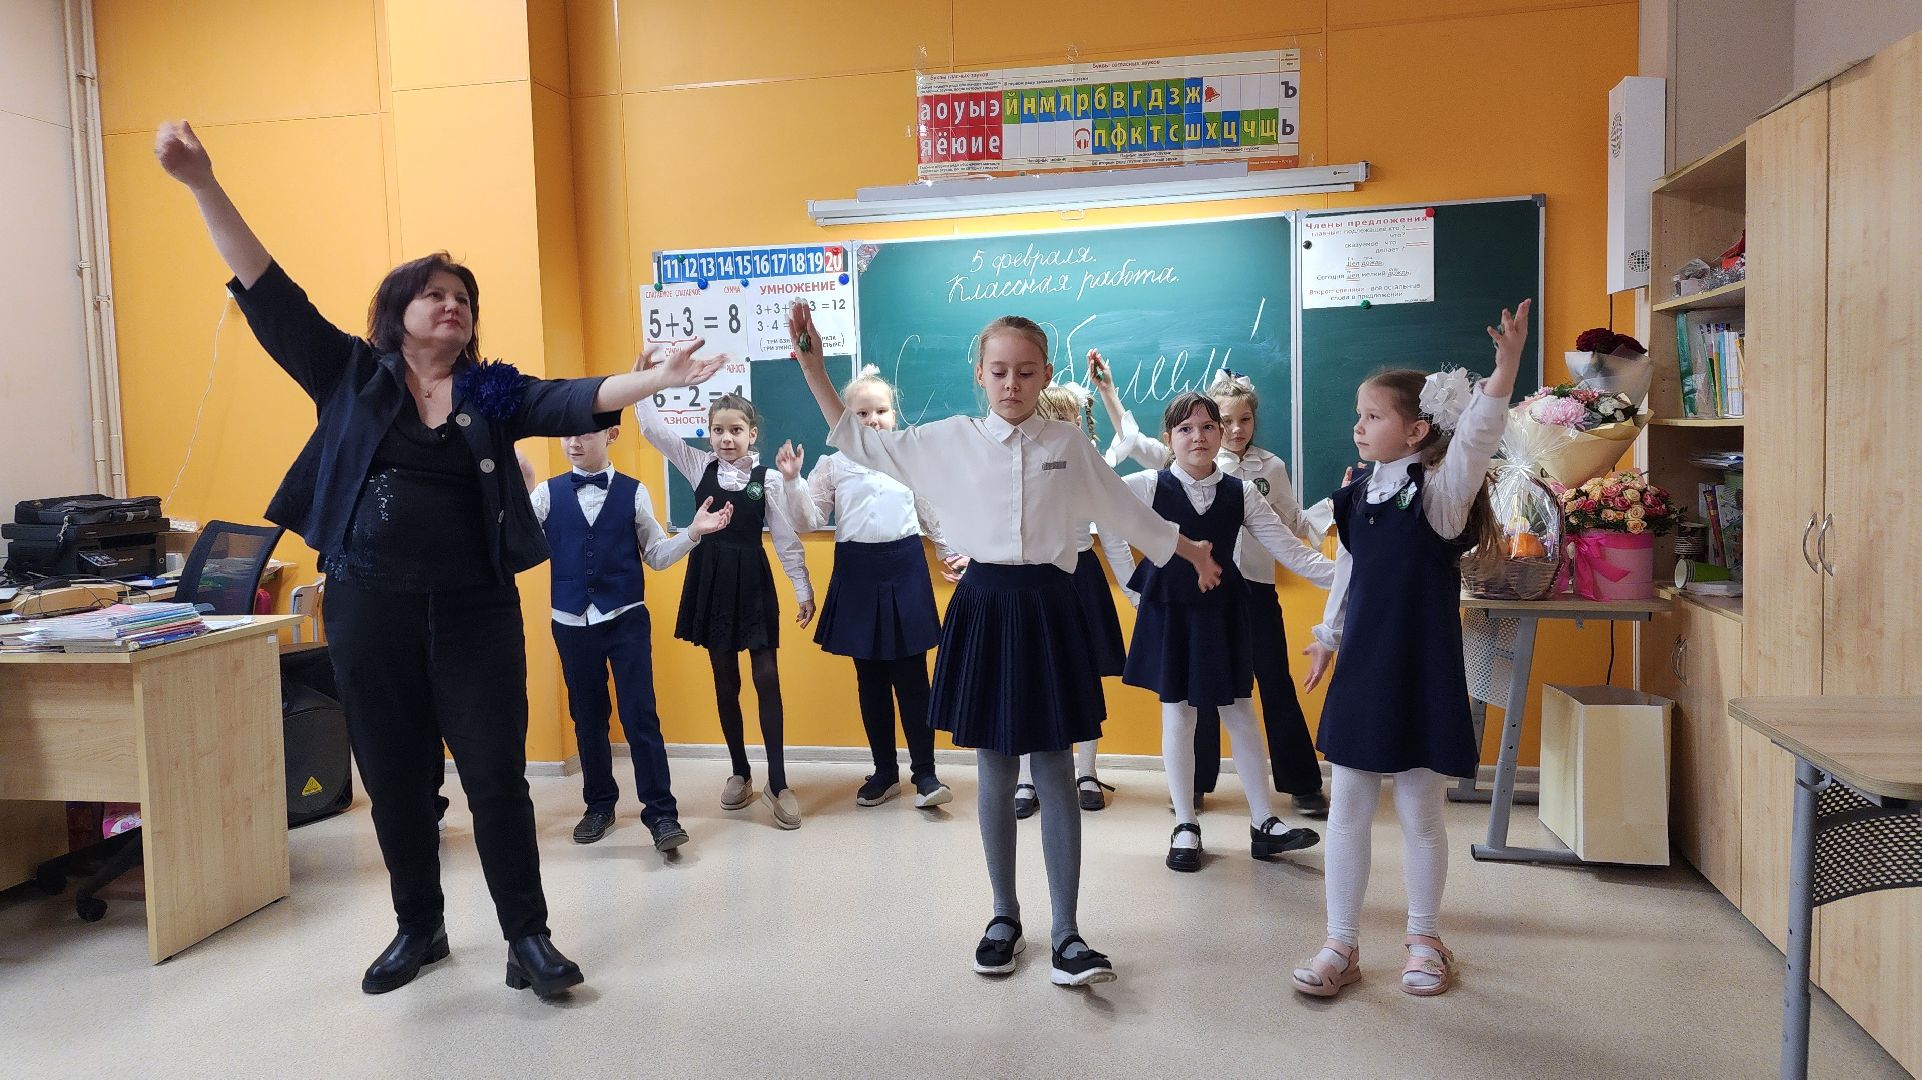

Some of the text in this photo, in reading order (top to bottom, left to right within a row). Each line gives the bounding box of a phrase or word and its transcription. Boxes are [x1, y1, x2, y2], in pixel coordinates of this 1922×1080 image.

[920, 80, 1298, 124] а о у ы э й н м л р б в г д з ж ъ
[920, 119, 1294, 156] я ё ю и е п ф к т с ш х ц ч щ ь
[1305, 216, 1428, 230] Члены предложения
[664, 252, 842, 278] 11 12 13 14 15 16 17 18 19 20
[970, 243, 1097, 276] 5 февраля.
[760, 280, 836, 296] УМНОЖЕНИЕ
[946, 258, 1180, 304] Классная работа.
[653, 392, 666, 408] 6
[689, 386, 700, 407] 2
[664, 416, 707, 425] АЗНОСТЬ
